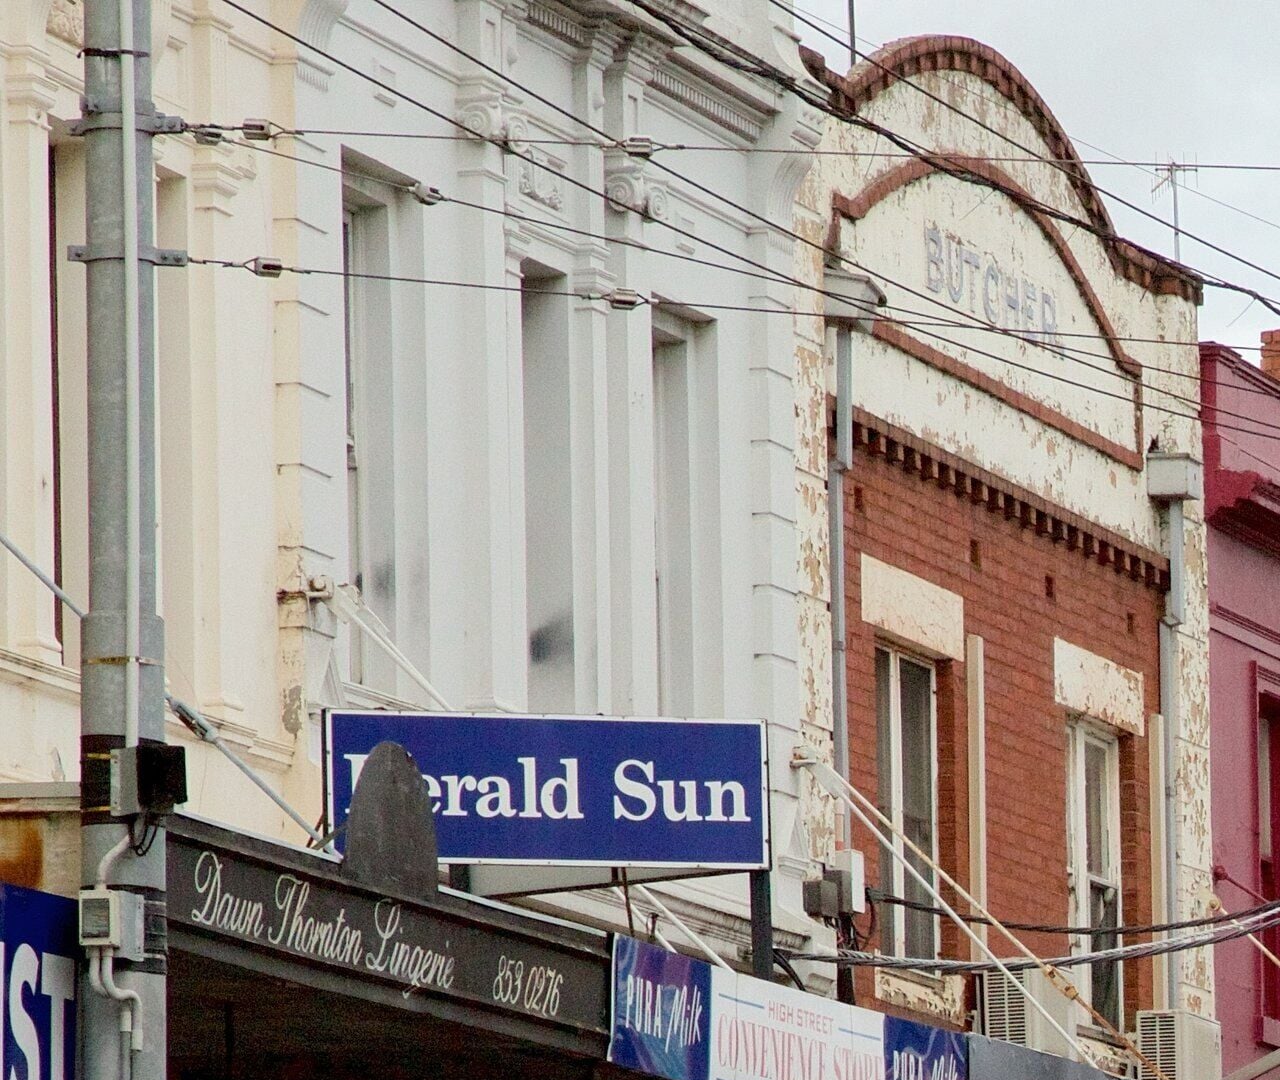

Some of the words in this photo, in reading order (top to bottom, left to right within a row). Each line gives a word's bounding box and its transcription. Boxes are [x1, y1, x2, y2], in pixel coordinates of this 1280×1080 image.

[923, 222, 1066, 361] BUTCHER
[344, 754, 584, 820] erald
[613, 759, 751, 822] Sun
[191, 851, 264, 938] Dawn
[268, 873, 362, 965] Thornton
[365, 899, 455, 999] Lingerie
[493, 955, 522, 1004] 853
[524, 967, 563, 1016] 0276
[625, 975, 662, 1038] PURA
[664, 983, 703, 1054] Milk
[768, 1000, 795, 1027] HIGH
[796, 1006, 834, 1034] STREET
